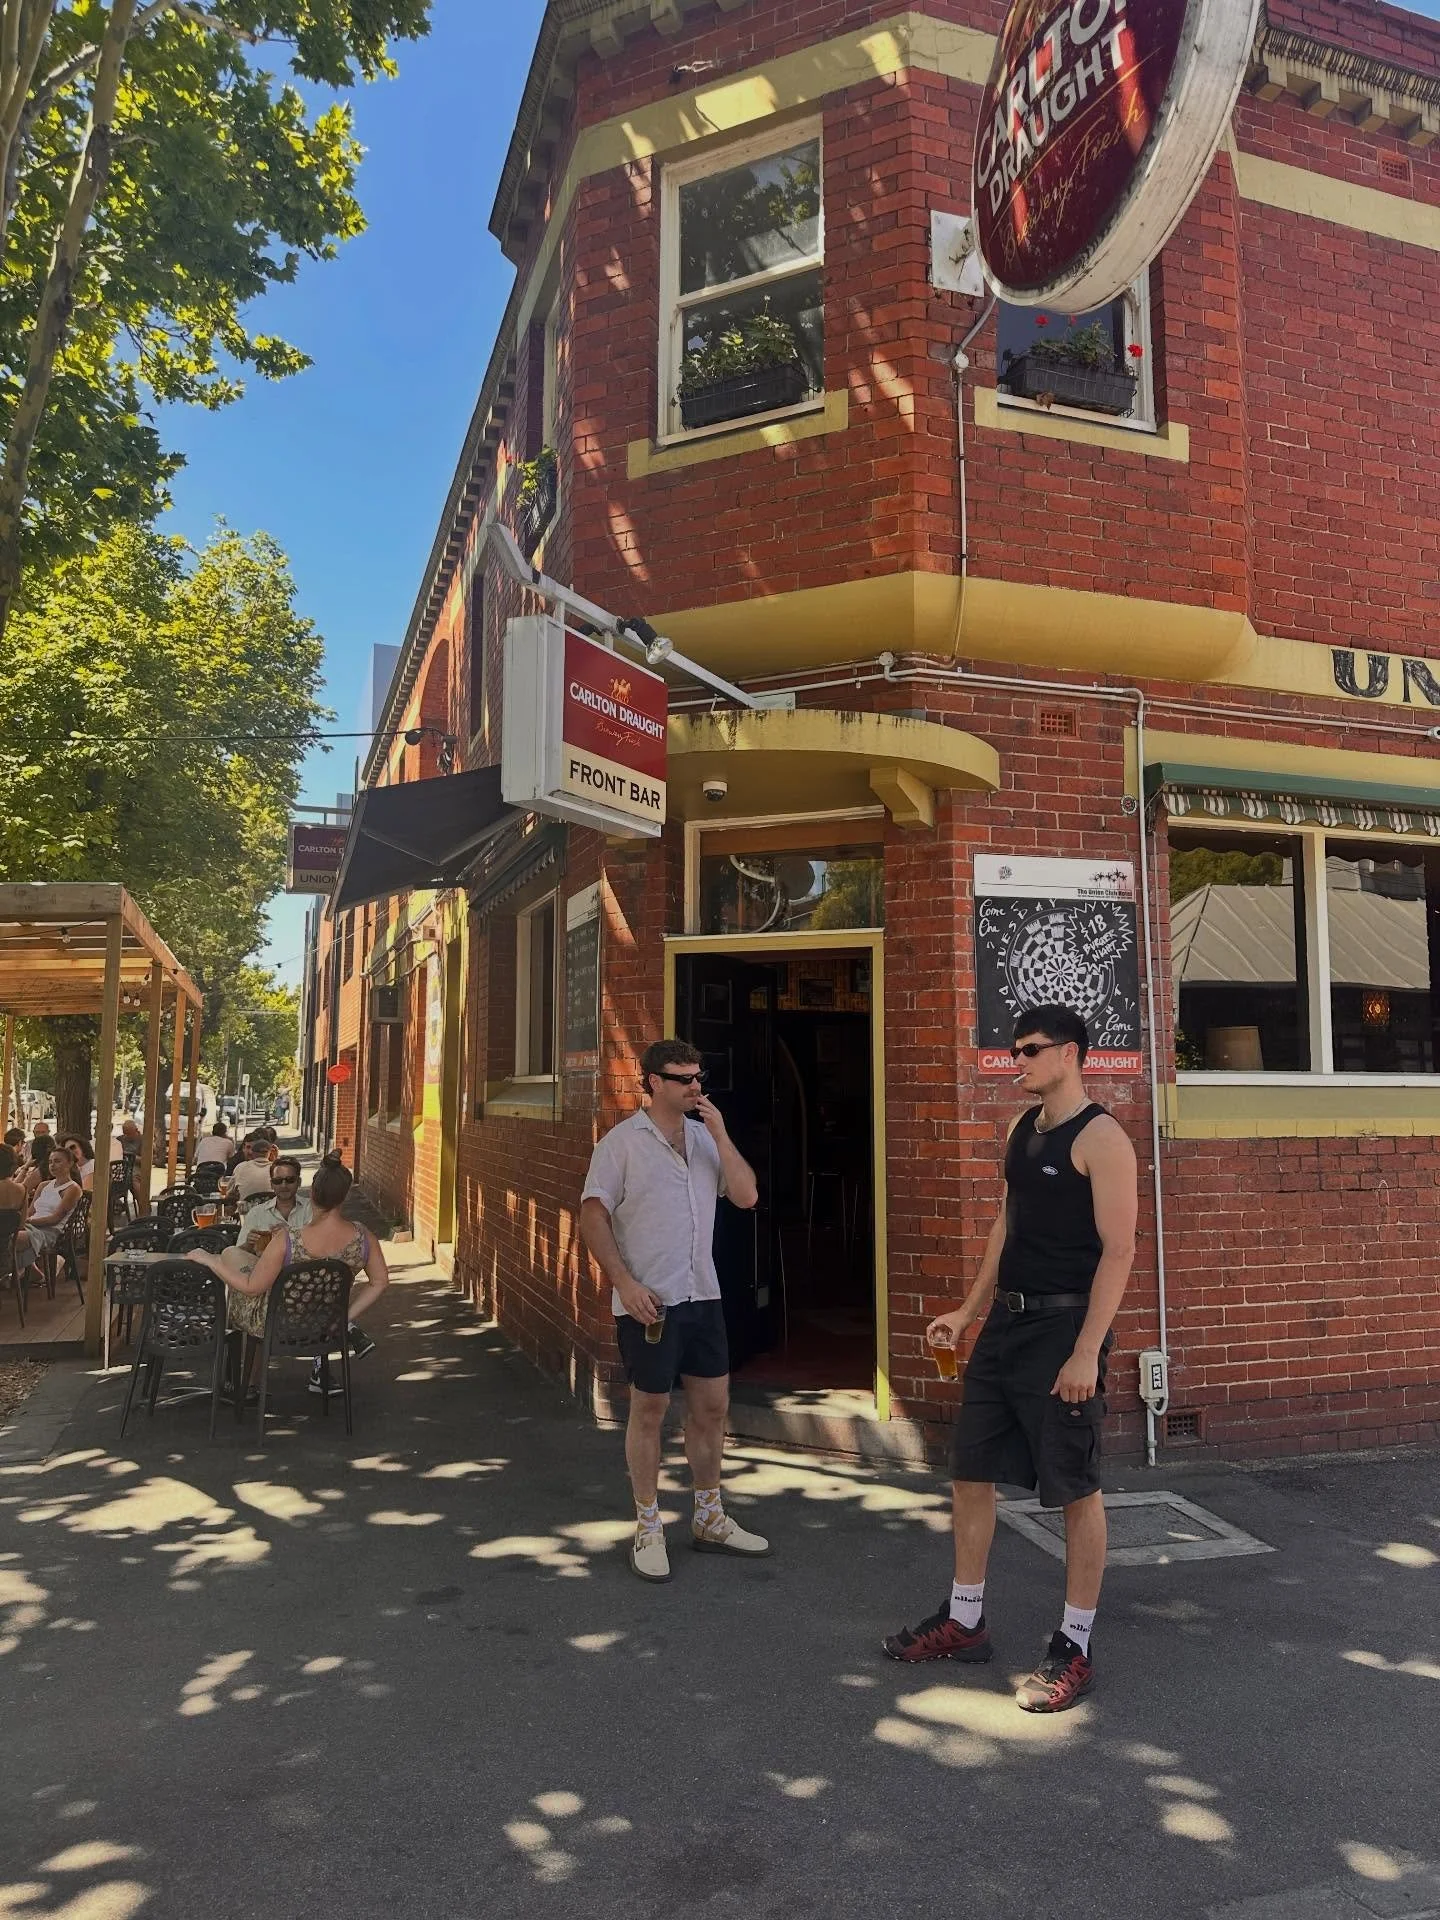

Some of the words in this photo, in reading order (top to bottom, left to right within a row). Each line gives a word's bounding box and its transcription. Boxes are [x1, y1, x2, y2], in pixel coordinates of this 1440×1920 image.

[978, 0, 1127, 189] CARLTO
[989, 19, 1127, 217] DRAUGHT
[1070, 88, 1145, 177] Fresh
[570, 682, 617, 719] CARLTON
[619, 708, 665, 740] DRAUGHT
[570, 759, 626, 797] FRONT
[630, 783, 661, 810] BAR
[298, 844, 337, 854] CARLTON
[979, 899, 1006, 917] Come
[1105, 1014, 1134, 1031] Come
[982, 1054, 1017, 1068] CARL
